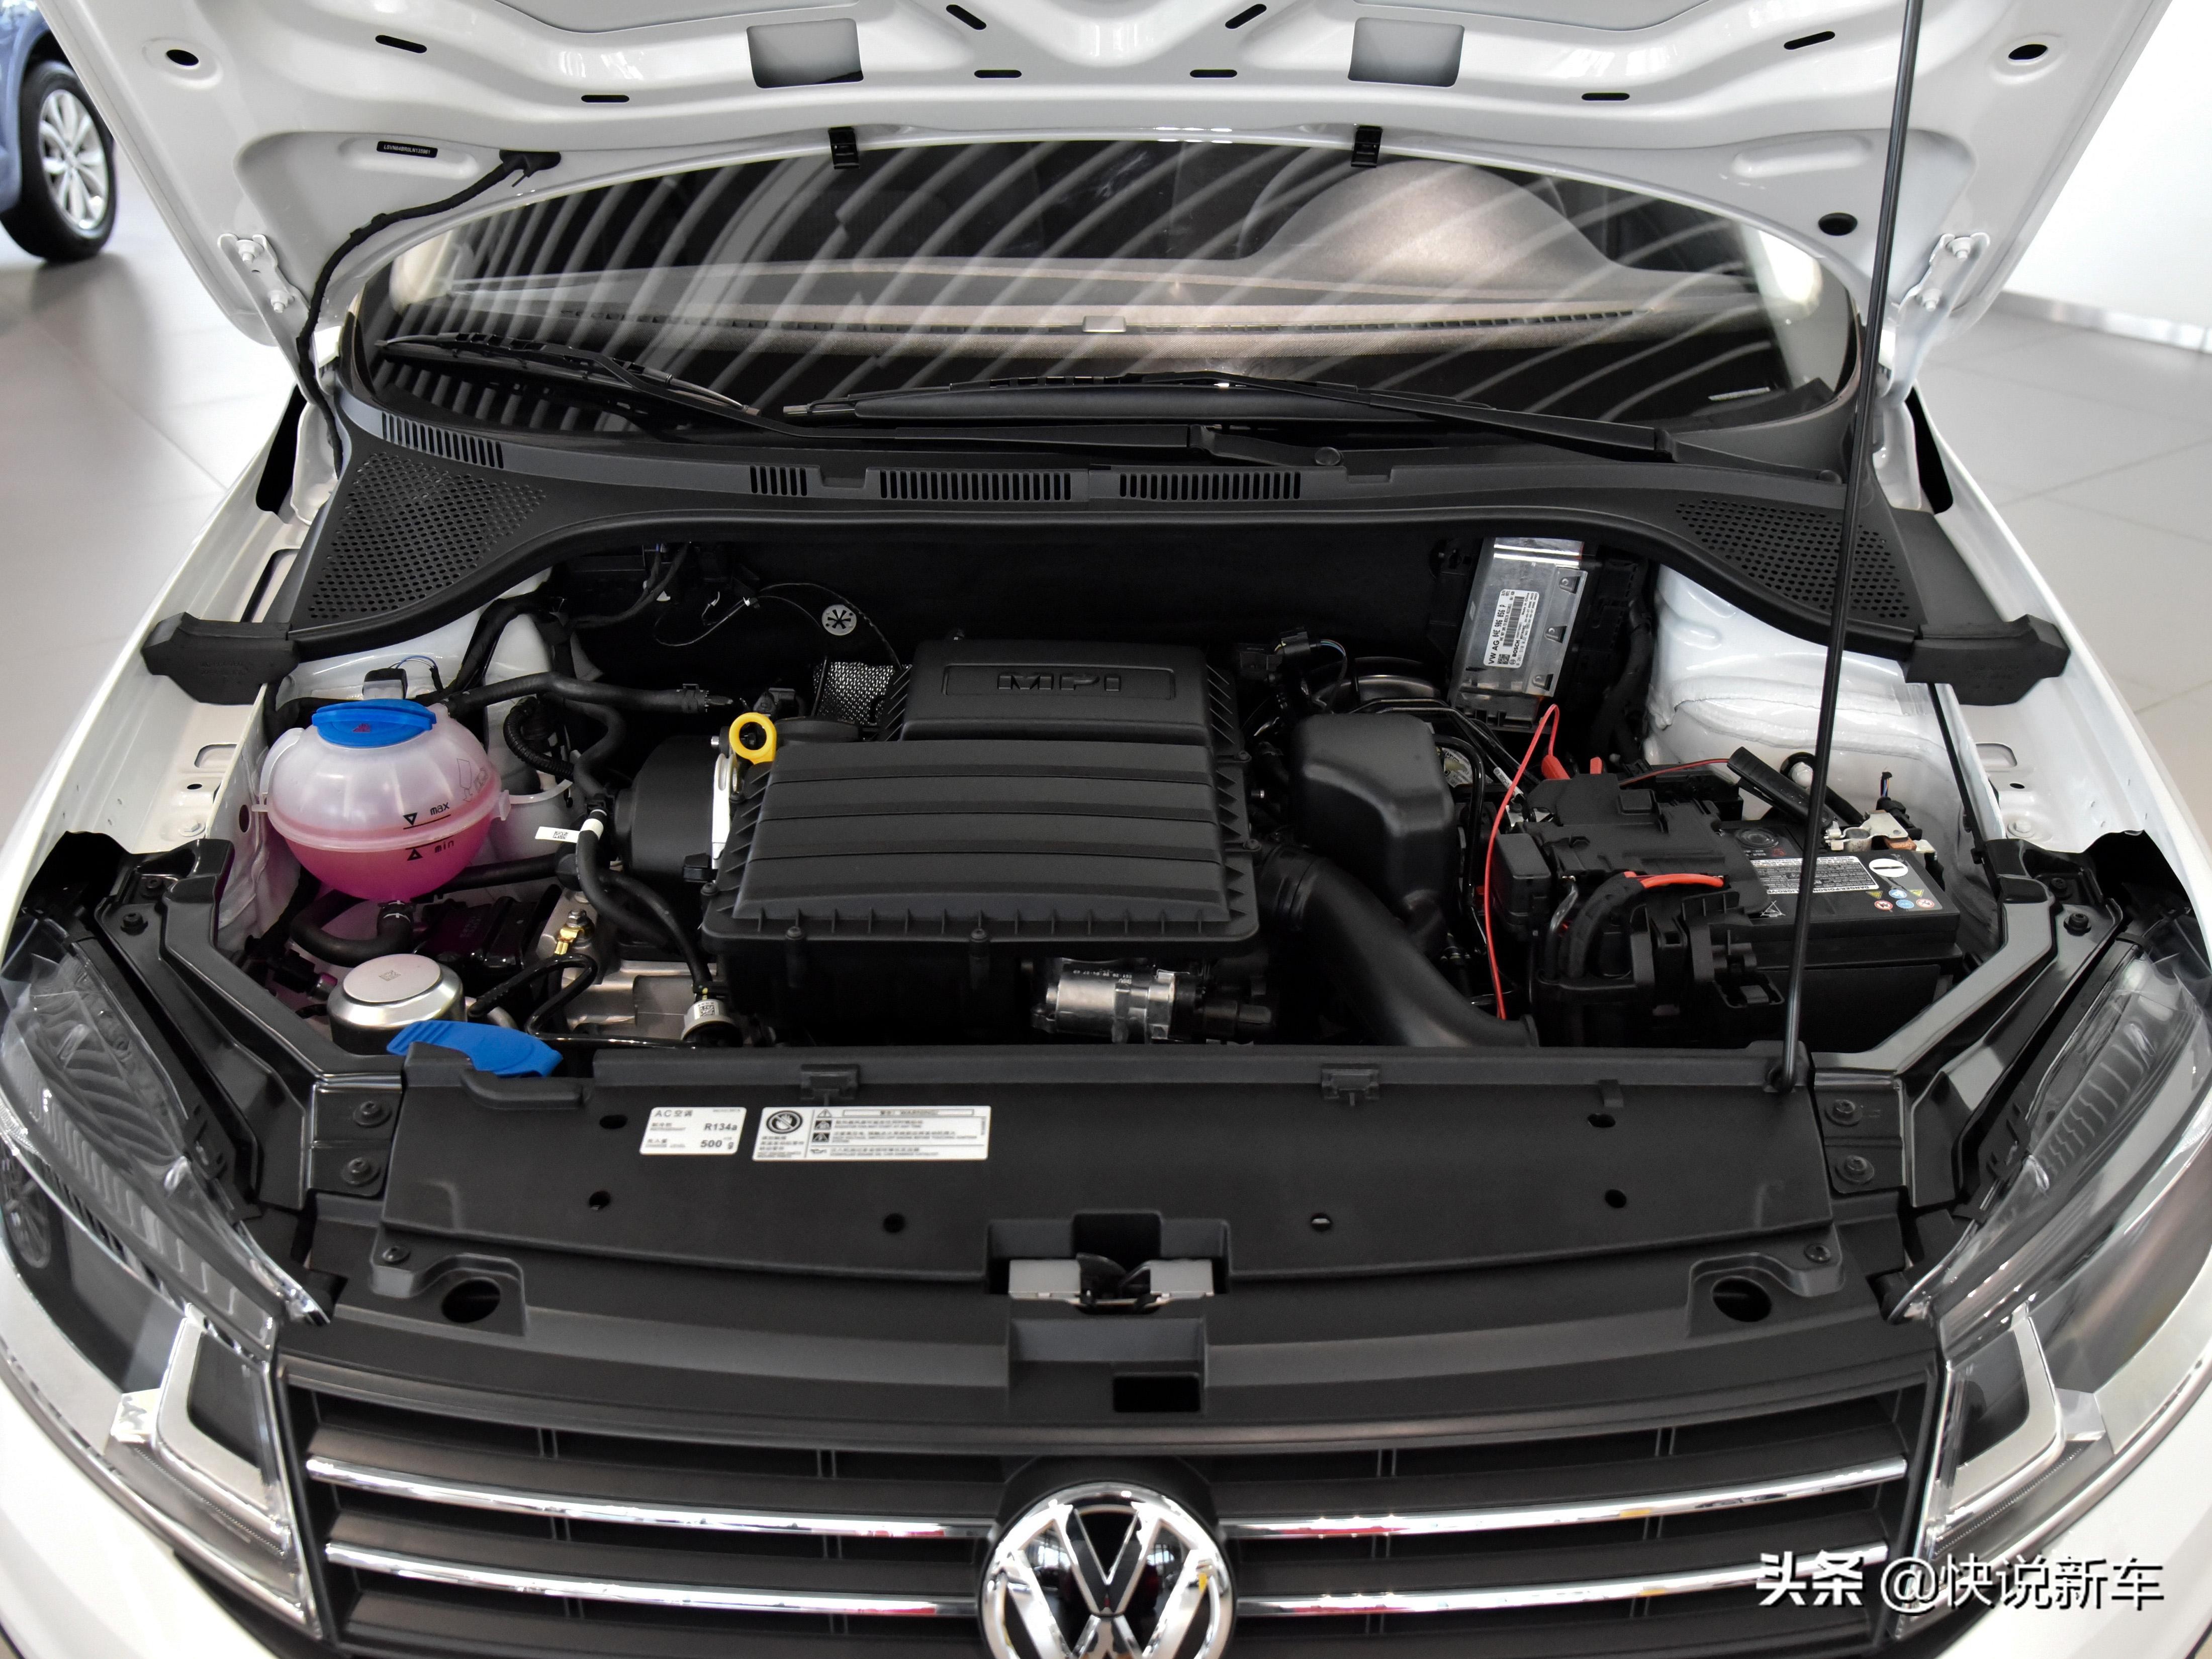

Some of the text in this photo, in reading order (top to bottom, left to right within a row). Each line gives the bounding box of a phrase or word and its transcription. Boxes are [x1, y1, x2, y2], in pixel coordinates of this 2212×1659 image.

[1492, 640, 1499, 651] AG
[1512, 640, 1520, 657] BOSCH
[1489, 653, 1496, 664] VW
[997, 673, 1122, 692] MPI
[430, 802, 450, 815] max
[434, 840, 454, 853] min
[674, 1109, 693, 1118] 空调
[704, 1123, 738, 1131] R134a
[700, 1140, 734, 1150] 500 g
